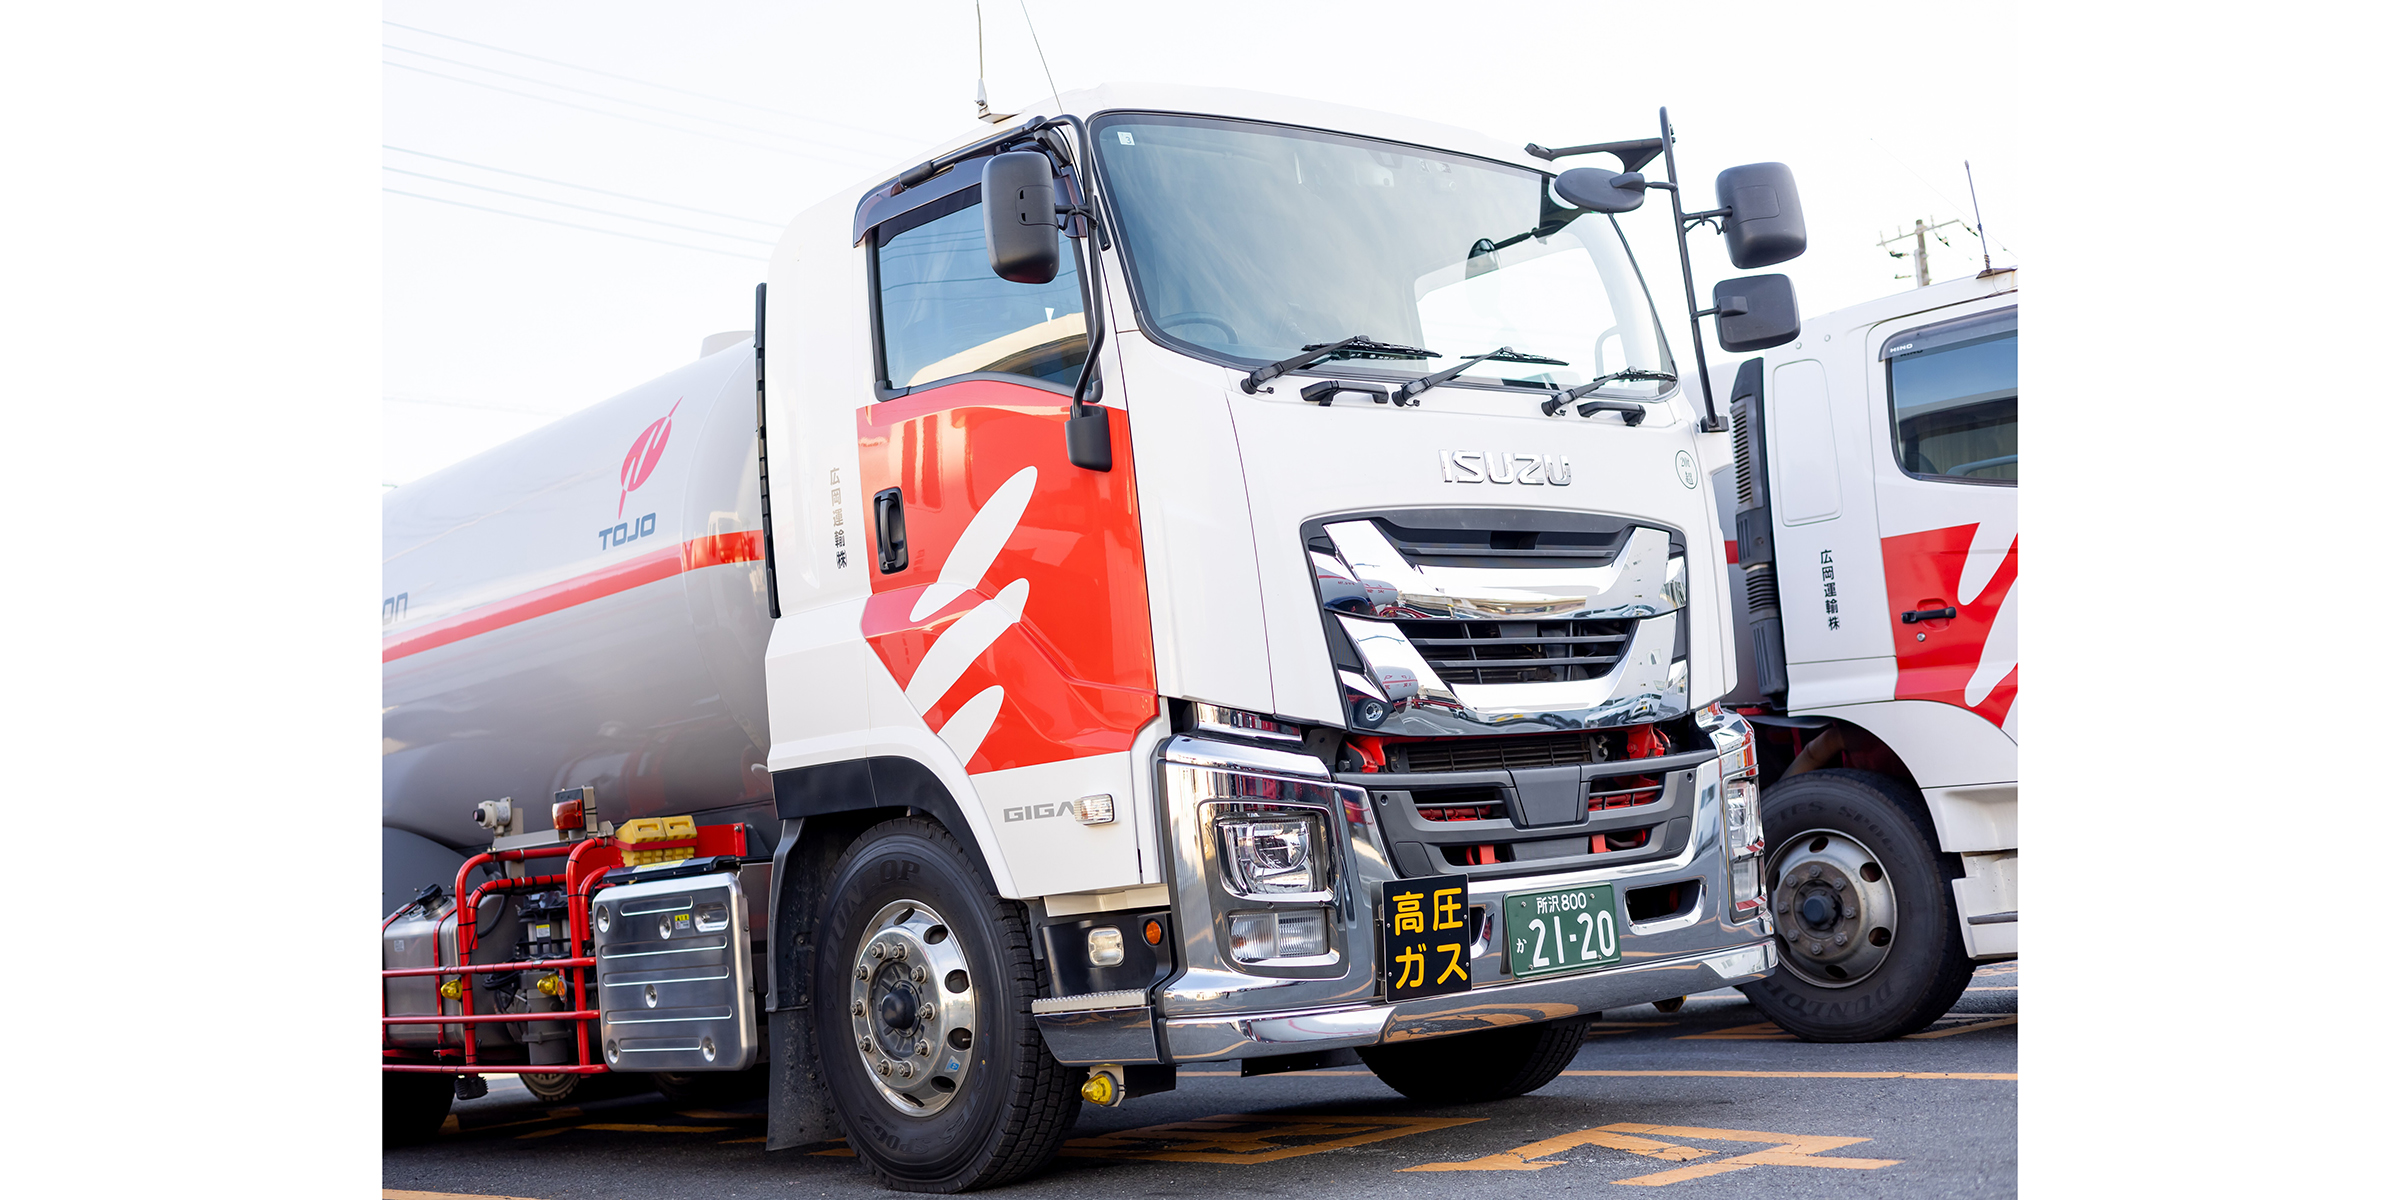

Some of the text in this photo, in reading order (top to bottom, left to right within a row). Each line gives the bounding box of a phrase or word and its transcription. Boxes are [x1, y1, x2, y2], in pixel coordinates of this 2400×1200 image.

[1889, 343, 1914, 354] HINO
[1438, 449, 1572, 486] ISUZU
[598, 512, 656, 551] TOJO
[1003, 801, 1075, 823] GIGA
[824, 859, 920, 973] DUNLOP
[1392, 887, 1462, 936] 高圧
[1516, 938, 1527, 953] か
[1395, 943, 1468, 989] ガス
[1761, 976, 1894, 1017] DUNLOP
